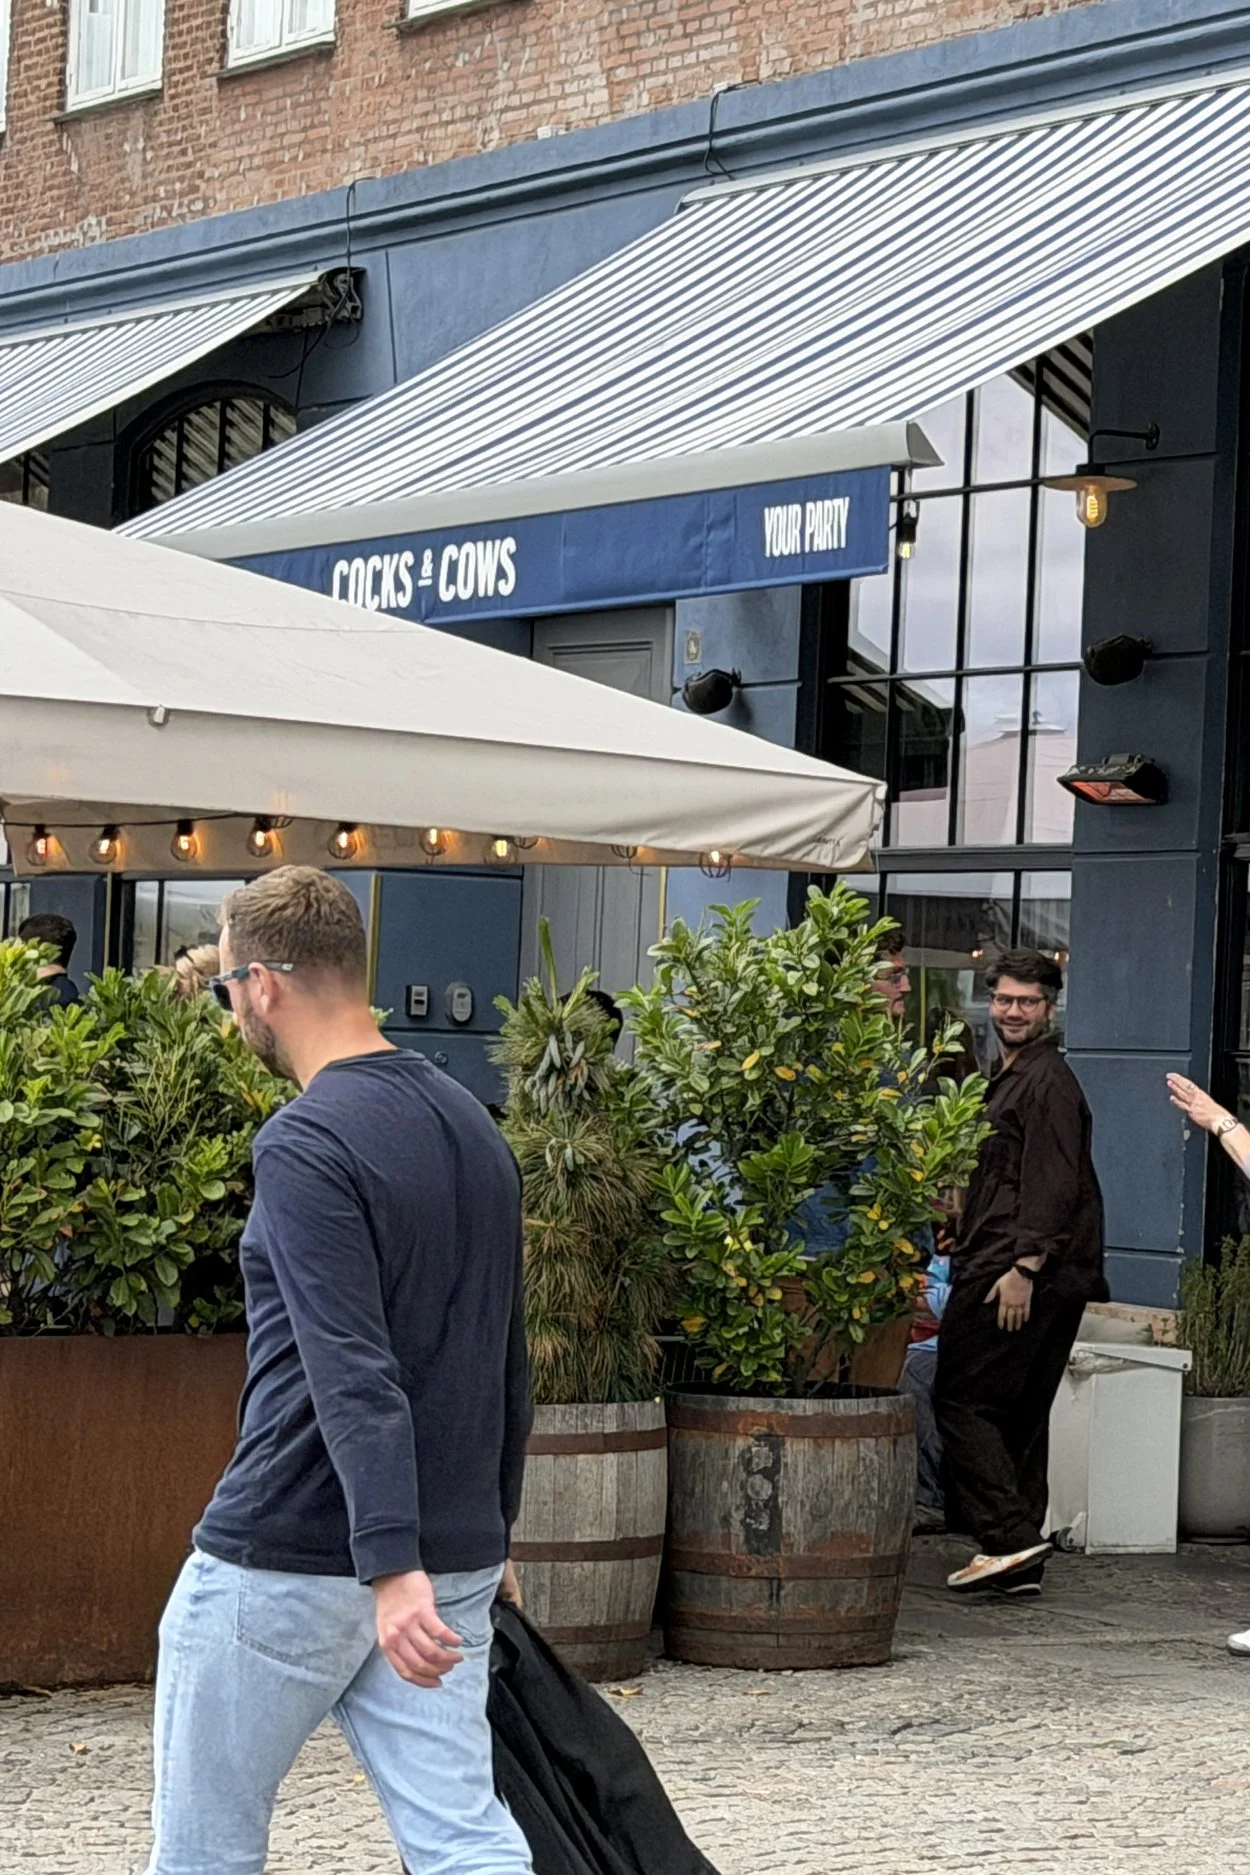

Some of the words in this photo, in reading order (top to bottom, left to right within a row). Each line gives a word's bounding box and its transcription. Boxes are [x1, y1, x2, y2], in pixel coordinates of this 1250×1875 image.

[763, 502, 803, 558] YOUR
[804, 495, 851, 554] PARTY
[332, 549, 415, 611] COCKS
[418, 548, 434, 587] &
[438, 536, 517, 602] COWS
